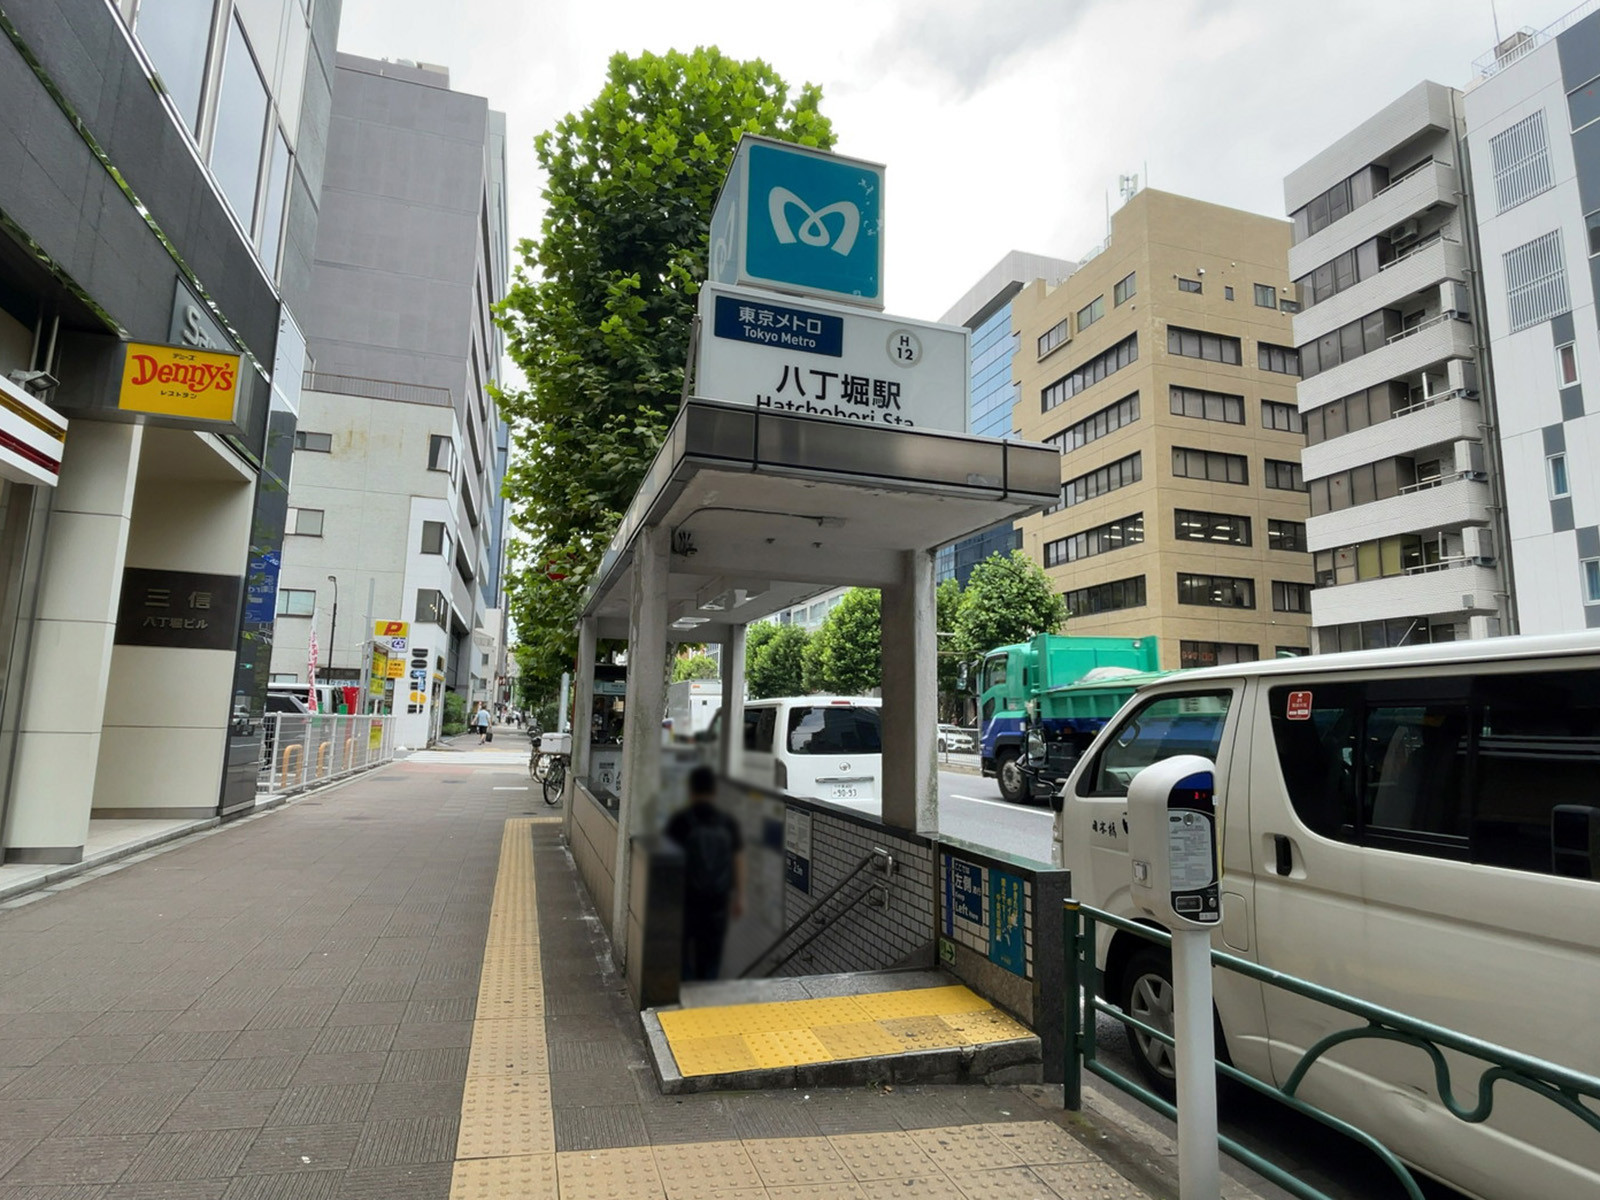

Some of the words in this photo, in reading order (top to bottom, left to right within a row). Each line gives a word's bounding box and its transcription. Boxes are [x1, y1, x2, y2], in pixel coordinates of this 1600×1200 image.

[738, 306, 822, 335] 東京メトロ
[743, 325, 778, 343] Tokyo
[781, 331, 816, 348] Metro
[900, 335, 910, 347] H
[897, 347, 914, 360] 12
[131, 354, 235, 393] Denny's
[776, 365, 901, 411] 八丁堀駅
[144, 588, 213, 609] 三信
[143, 616, 209, 629] 八丁堀ビル
